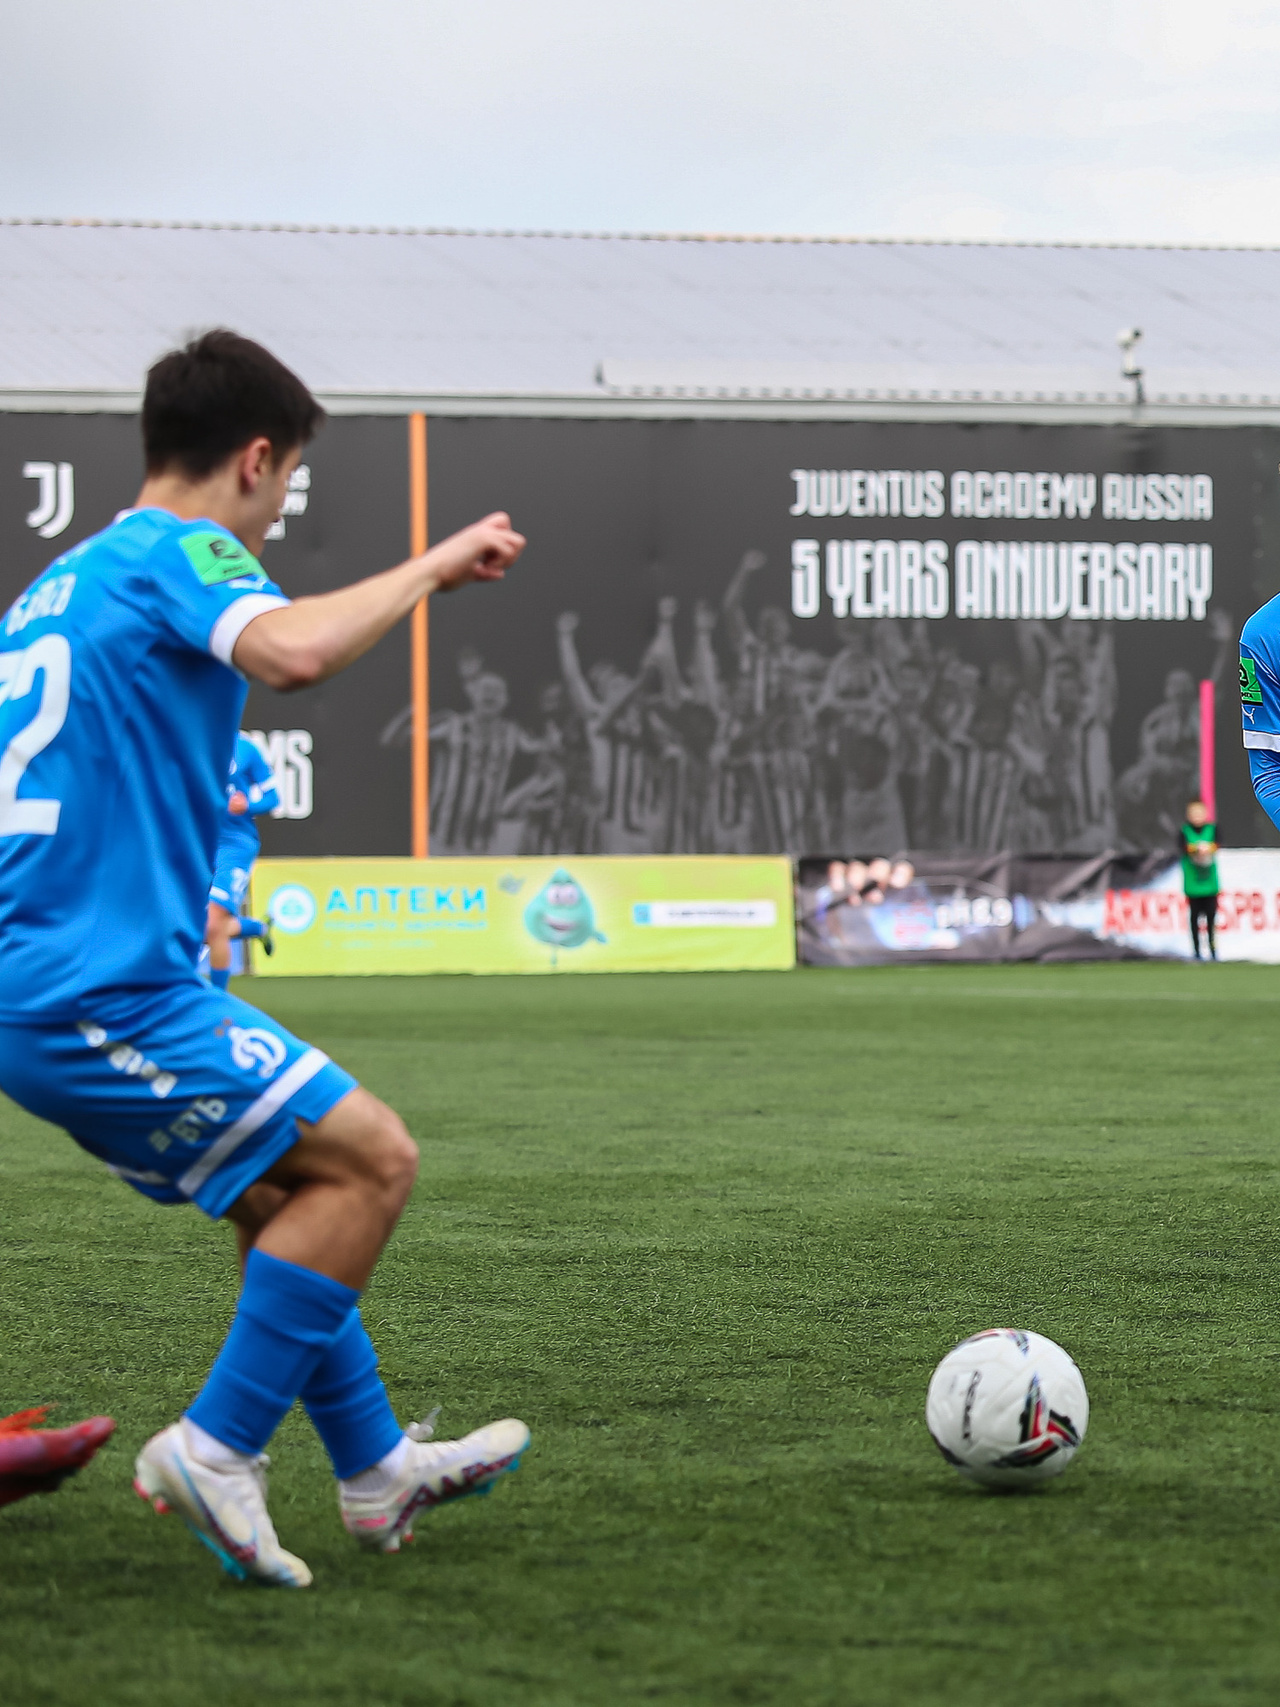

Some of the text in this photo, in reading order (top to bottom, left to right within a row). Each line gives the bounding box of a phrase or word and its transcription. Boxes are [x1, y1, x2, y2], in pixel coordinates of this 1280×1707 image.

[789, 469, 1214, 521] JUVENTUS ACADEMY RUSSIA
[791, 539, 1213, 621] 5 YEARS ANNIVERSARY
[326, 886, 486, 913] АПТЕКИ
